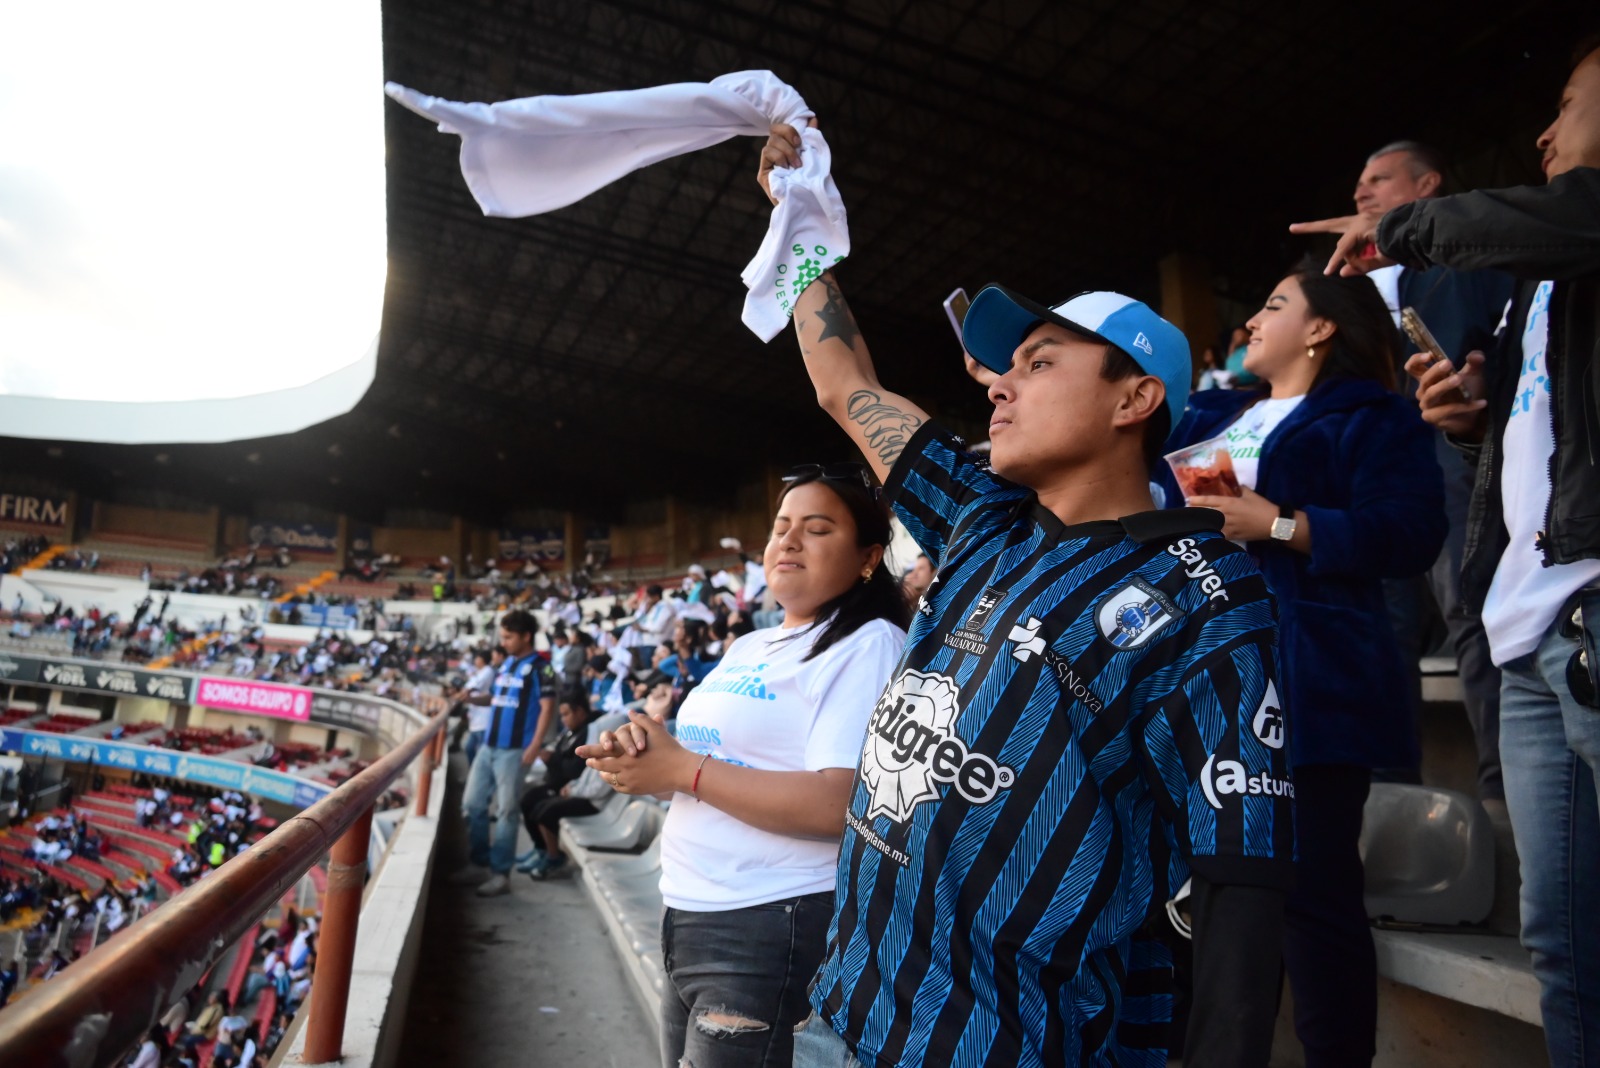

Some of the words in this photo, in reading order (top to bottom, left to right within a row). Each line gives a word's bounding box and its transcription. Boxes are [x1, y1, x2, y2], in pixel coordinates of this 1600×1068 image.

[944, 632, 987, 655] VALLADOLID
[202, 681, 249, 704] SOMOS
[251, 688, 293, 712] EQUIPO
